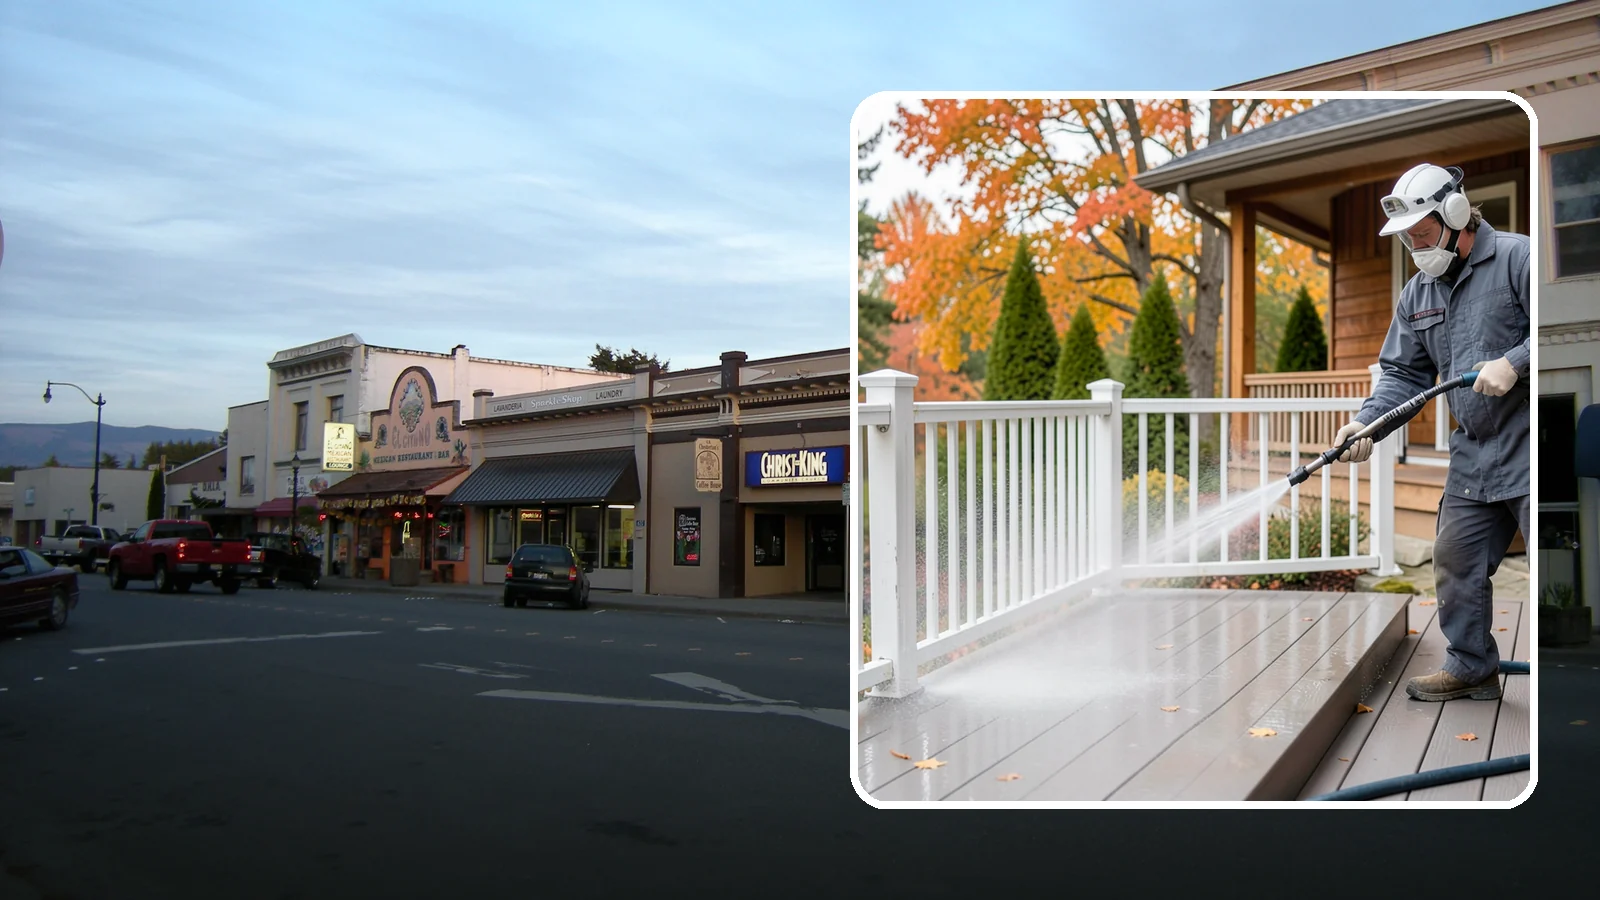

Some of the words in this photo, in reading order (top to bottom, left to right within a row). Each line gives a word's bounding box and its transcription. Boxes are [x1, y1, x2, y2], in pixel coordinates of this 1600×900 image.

[530, 398, 560, 409] Sparkle
[561, 394, 582, 404] Shop
[595, 389, 624, 400] LAUNDRY
[493, 402, 522, 413] LAVANDERIA
[373, 455, 396, 465] MEXICAN
[397, 451, 433, 462] RESTAURANT
[437, 450, 450, 459] BAR
[761, 452, 797, 477] CHRIST
[799, 450, 827, 476] KING
